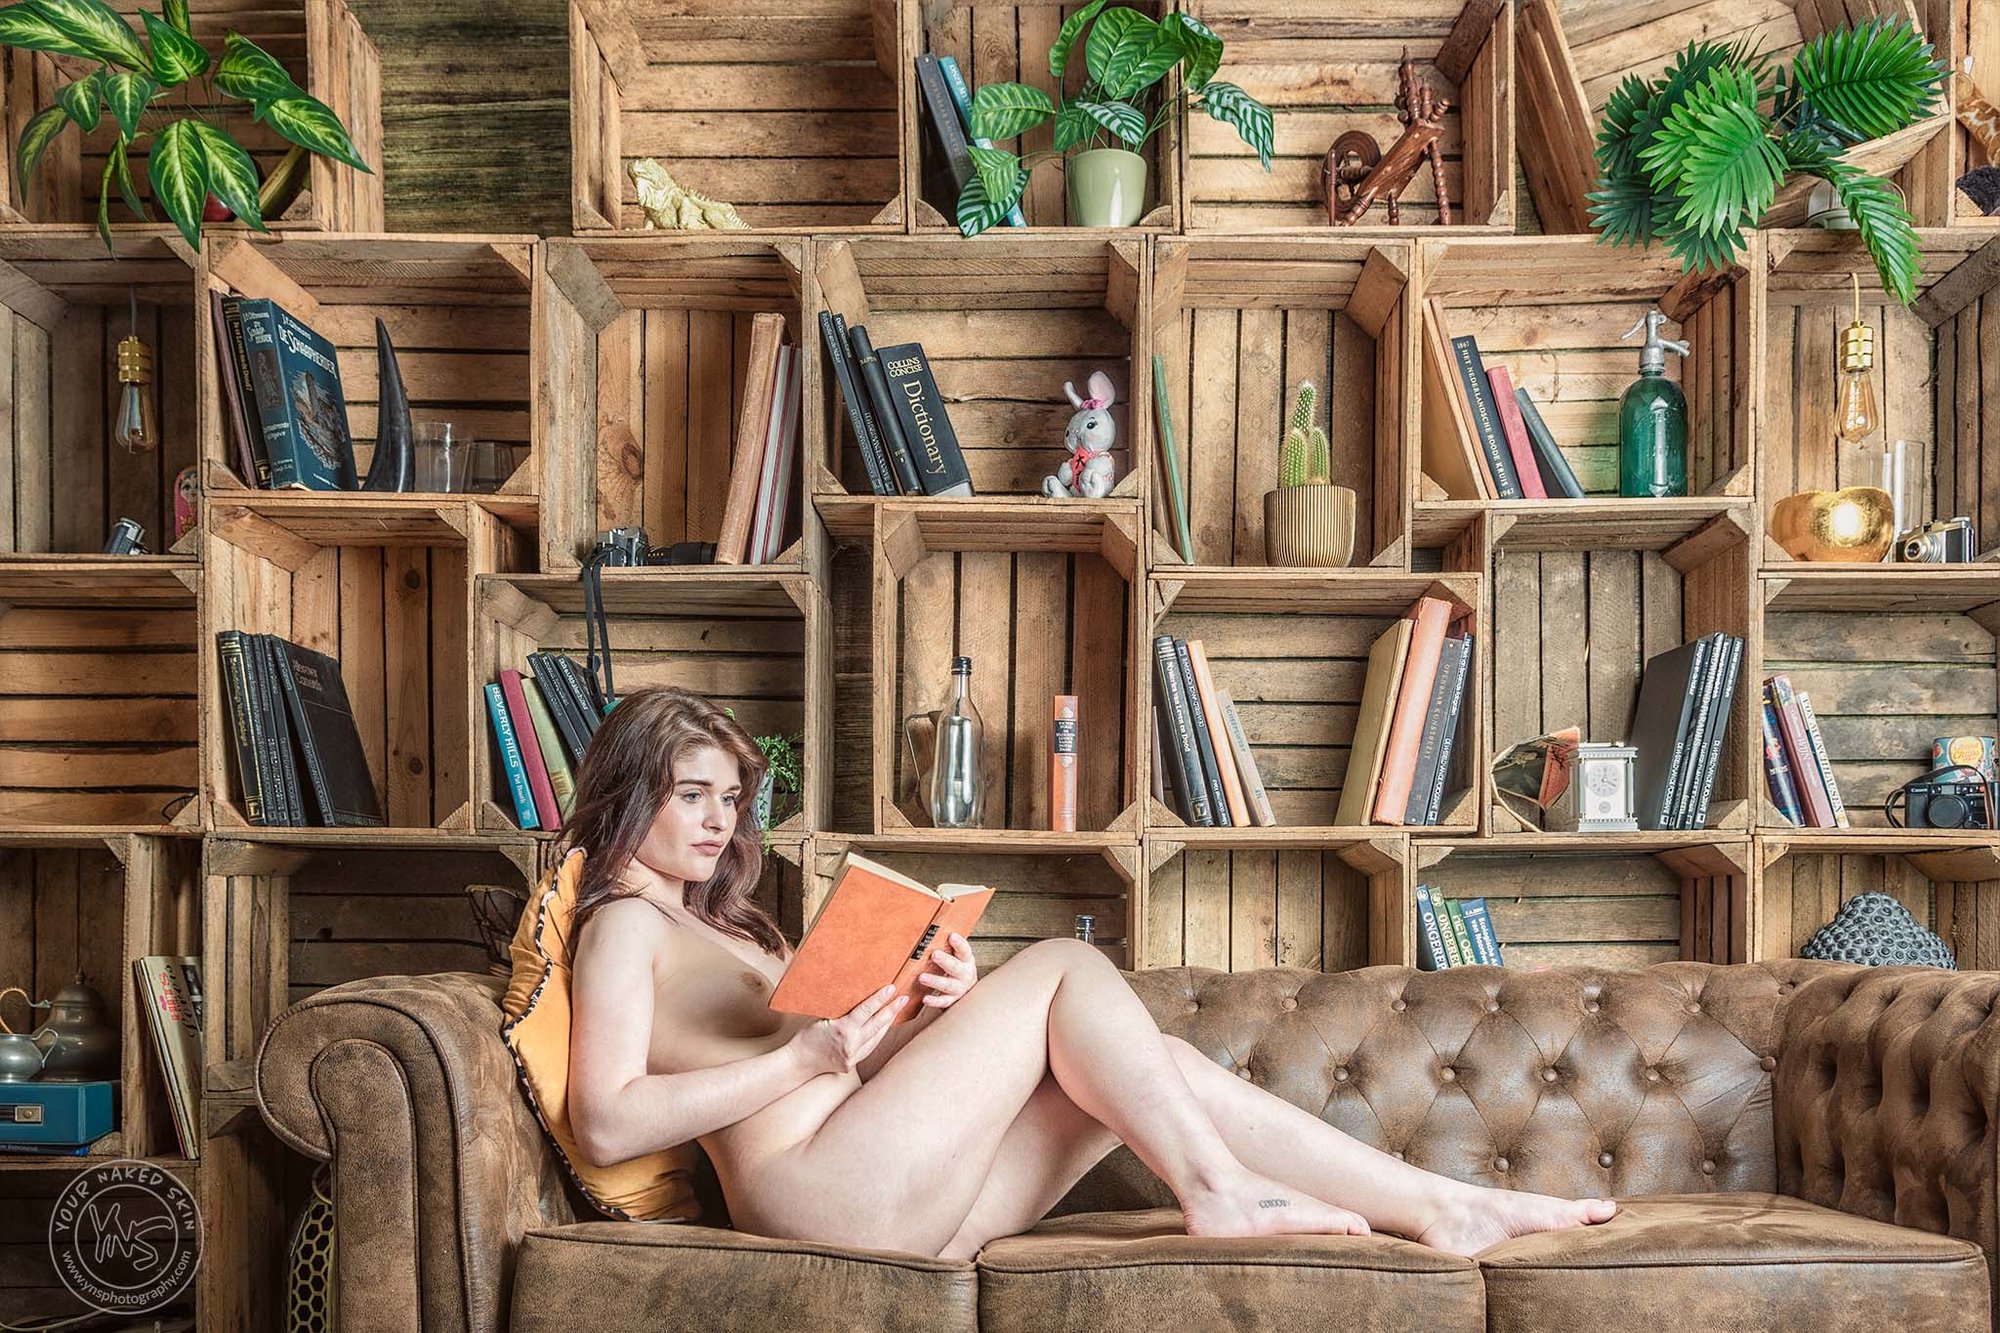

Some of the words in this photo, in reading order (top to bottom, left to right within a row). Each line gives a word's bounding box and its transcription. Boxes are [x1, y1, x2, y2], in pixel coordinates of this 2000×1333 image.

[887, 356, 920, 369] COLLINS
[889, 365, 923, 378] CONCISE
[902, 381, 946, 475] Dictionary
[1460, 349, 1472, 364] HET
[1466, 366, 1493, 434] NEDERLANDSCHE
[1486, 434, 1501, 461] ROODE
[1494, 461, 1509, 486] KRUIS
[1437, 663, 1451, 706] OPENBAAR
[1702, 641, 1722, 704] VERDWIJNEND
[1171, 693, 1180, 705] van
[1174, 704, 1185, 724] Leven
[1802, 698, 1814, 719] VON
[492, 687, 511, 736] BEVERLY
[504, 737, 519, 768] HILLS
[1178, 724, 1186, 733] en
[1424, 707, 1441, 759] KUNSTBEZIT
[1693, 705, 1709, 746] PARADIJS
[1180, 733, 1192, 753] Dood
[1453, 915, 1467, 935] HET
[1478, 917, 1495, 957] Ecologische
